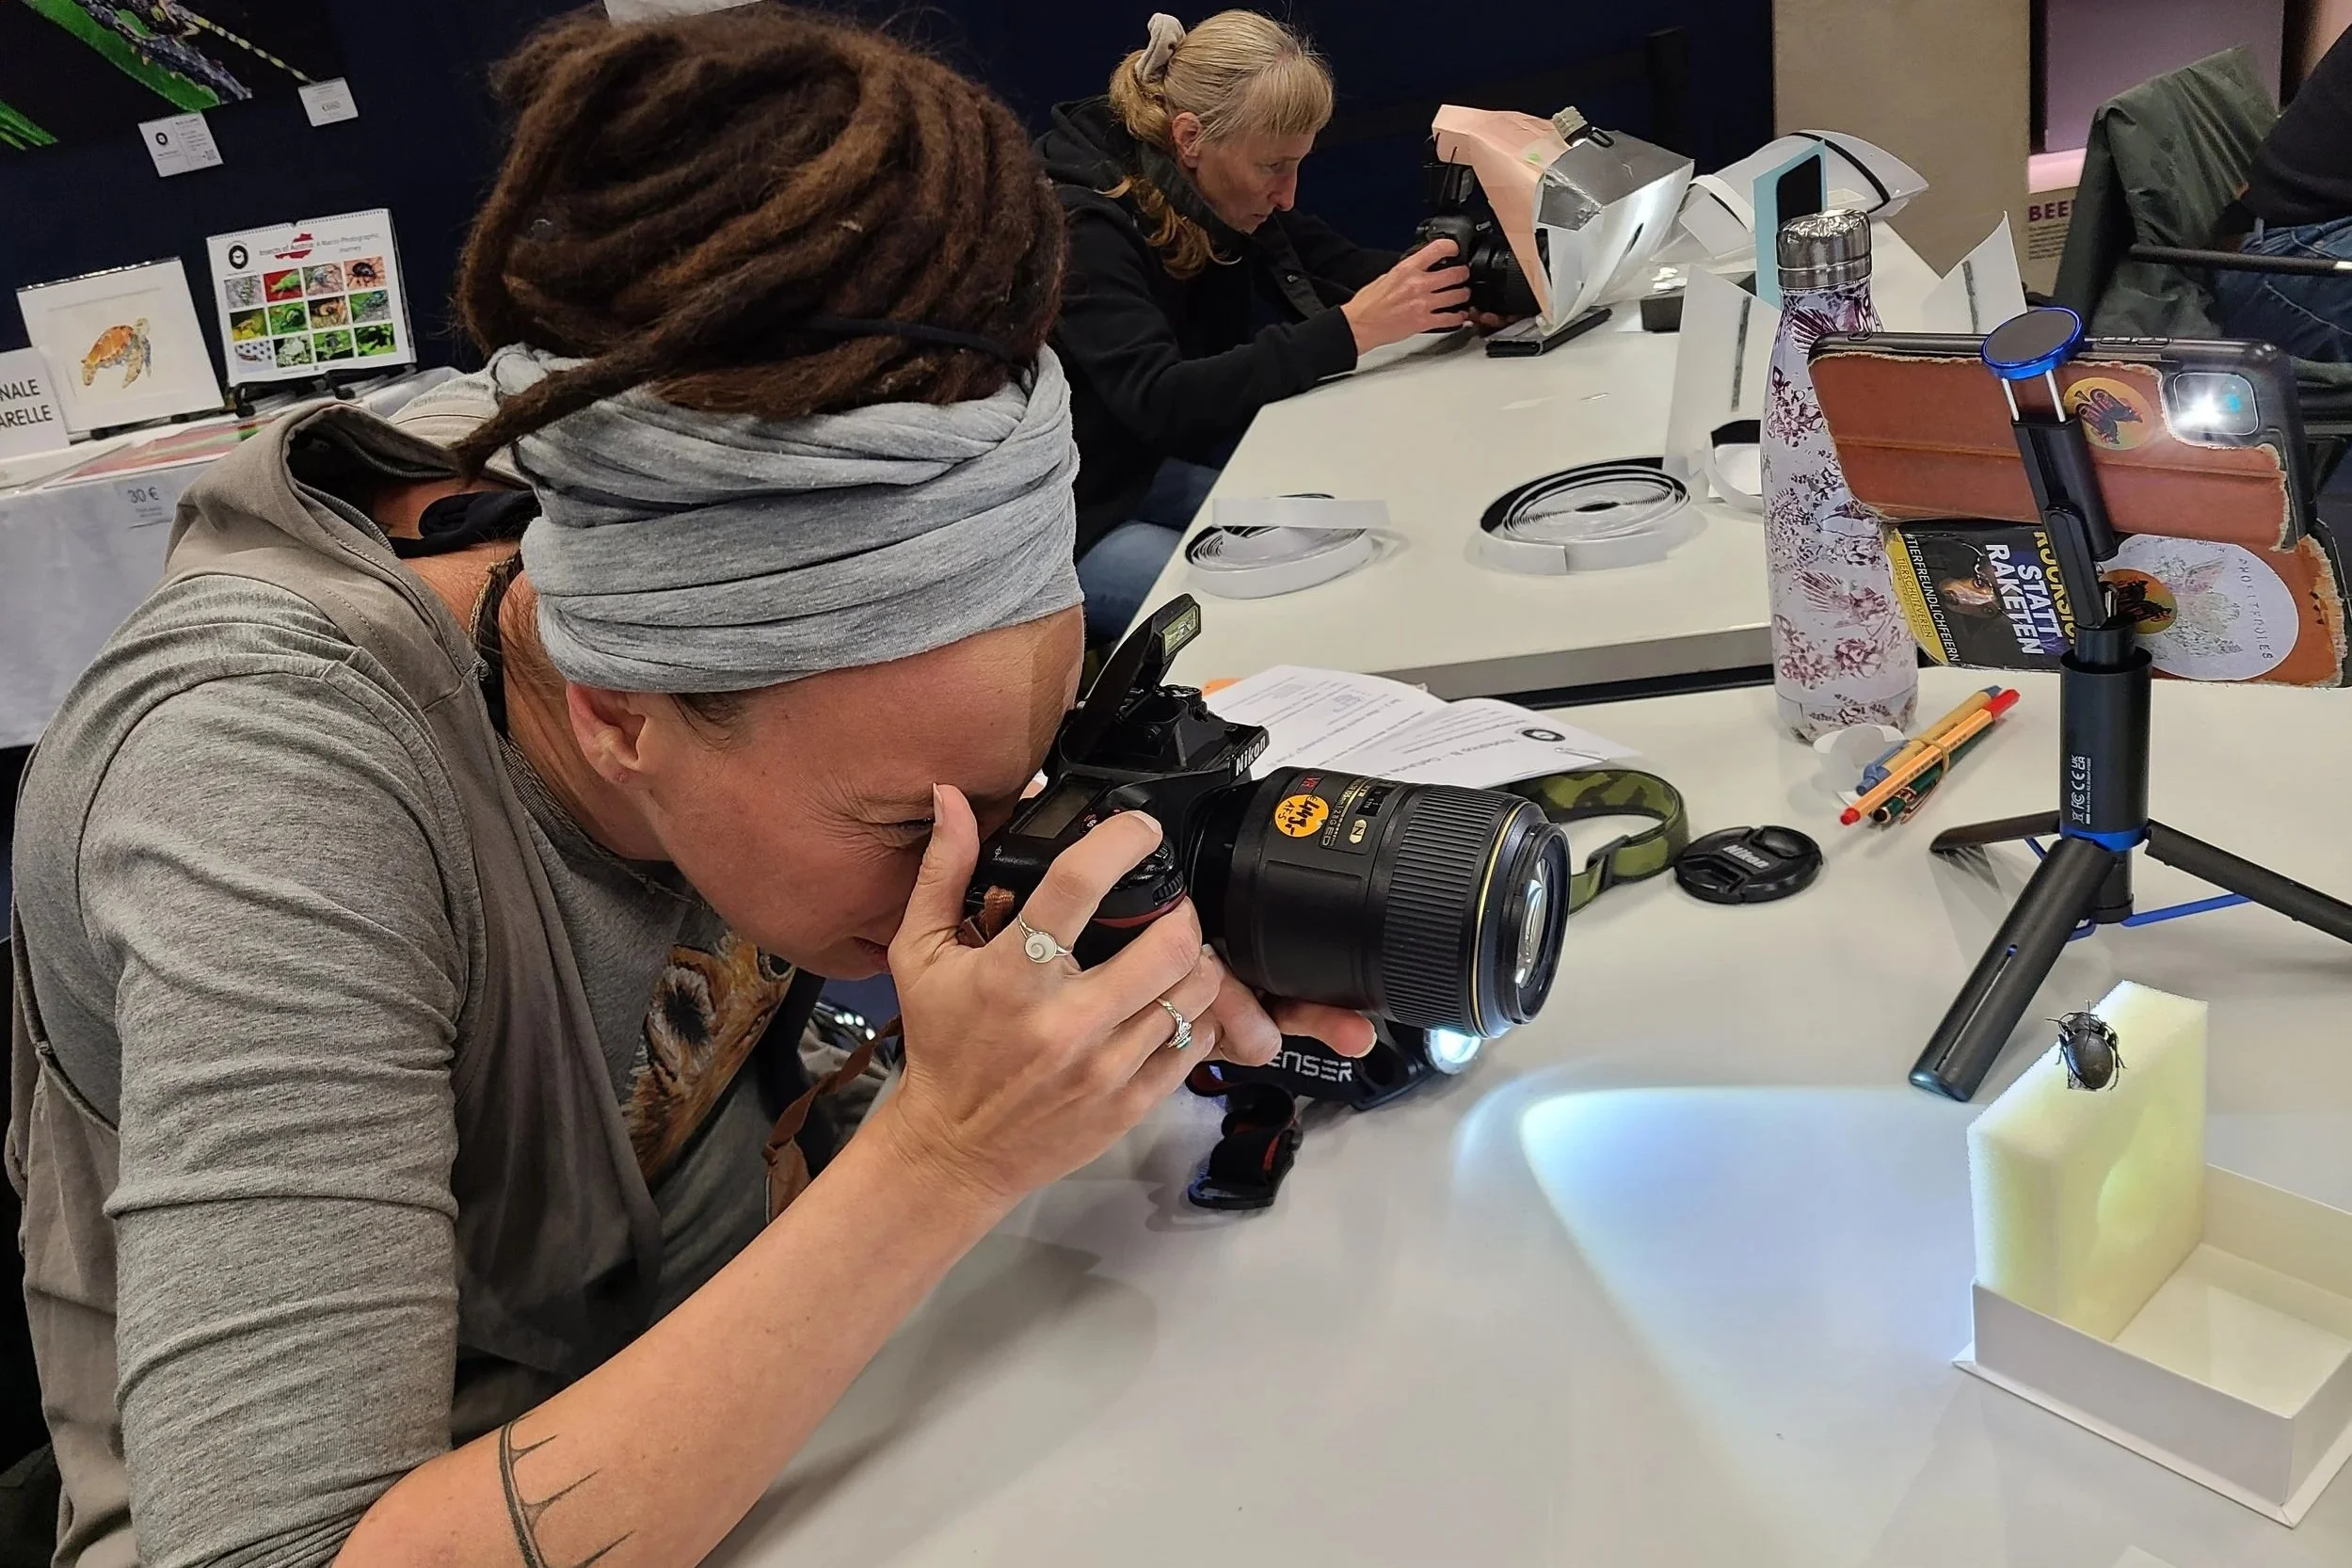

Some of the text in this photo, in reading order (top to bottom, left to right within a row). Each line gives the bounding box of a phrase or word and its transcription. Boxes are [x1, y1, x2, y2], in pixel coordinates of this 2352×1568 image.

[127, 486, 159, 504] 30 €
[1896, 557, 1933, 638] TIERSCHUTZVEREIN
[1985, 544, 2045, 654] RAKETEN
[2017, 564, 2063, 638] STATT
[1236, 735, 1266, 776] Nikon
[1277, 800, 1296, 821] AF-S
[1722, 844, 1769, 868] Nikon
